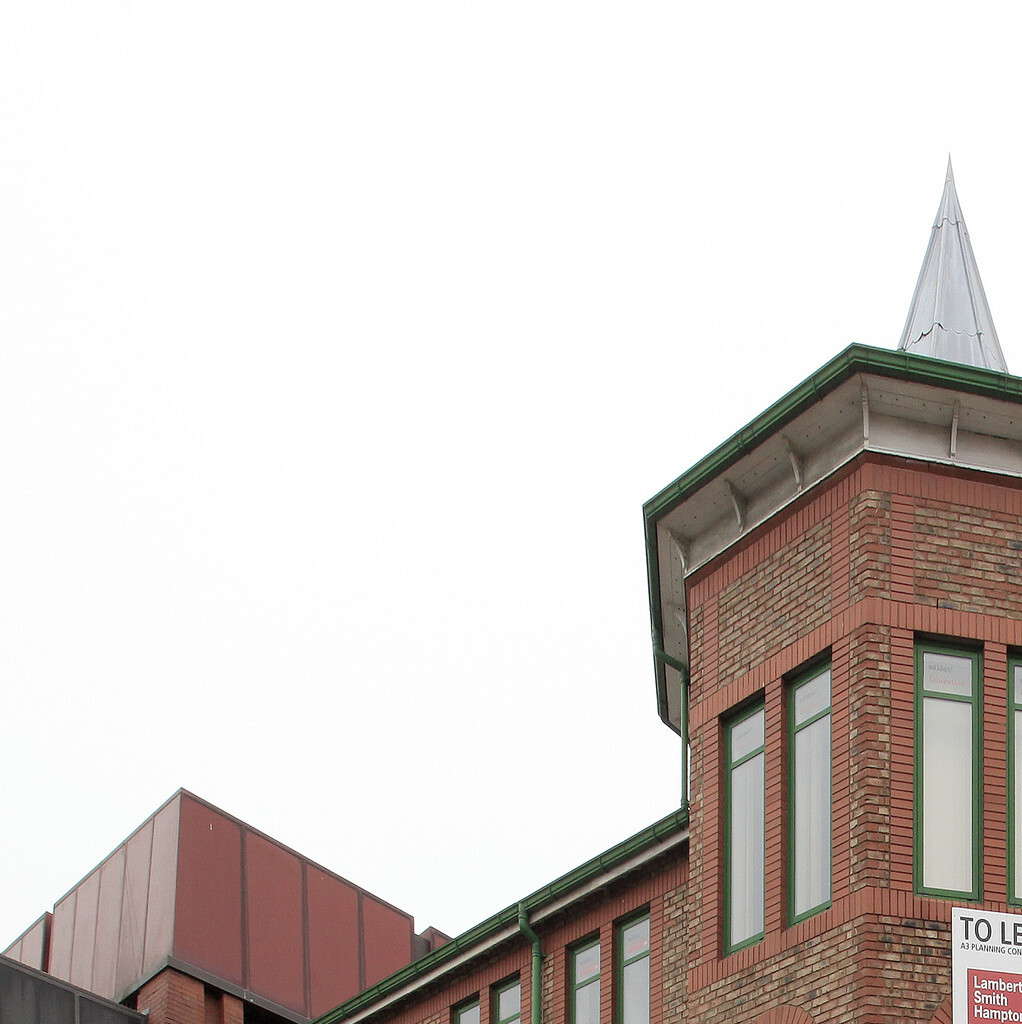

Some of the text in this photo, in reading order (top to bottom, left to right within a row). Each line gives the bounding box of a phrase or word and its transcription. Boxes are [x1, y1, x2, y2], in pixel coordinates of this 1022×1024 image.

[960, 916, 992, 943] TO
[960, 942, 970, 950] A3
[971, 944, 1006, 955] PLANNING
[973, 990, 1008, 1007] Smith
